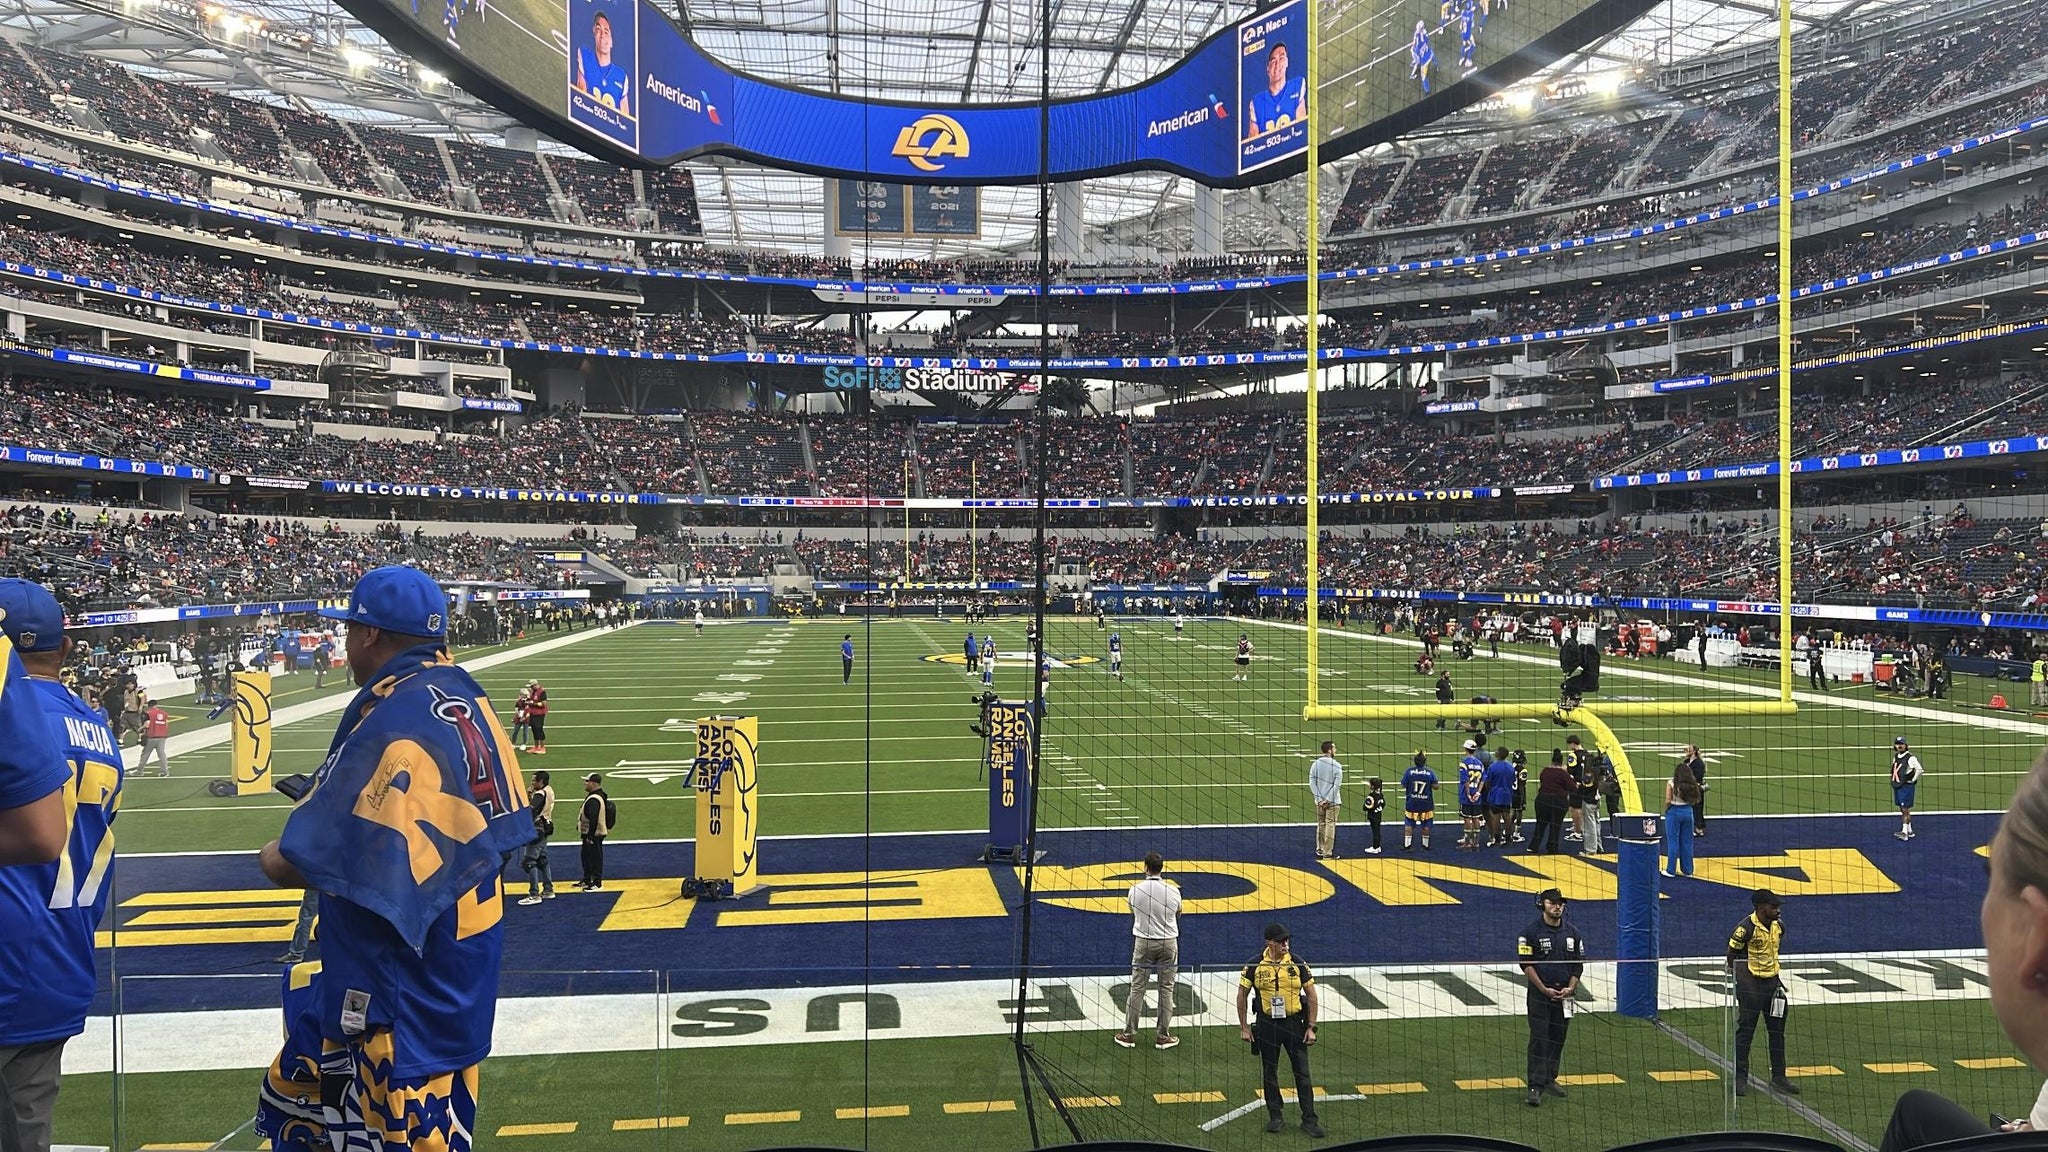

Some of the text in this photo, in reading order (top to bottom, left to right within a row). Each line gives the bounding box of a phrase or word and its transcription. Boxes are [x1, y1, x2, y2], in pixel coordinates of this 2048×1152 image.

[646, 73, 701, 113] American
[1148, 107, 1209, 138] American
[1266, 135, 1281, 148] 503
[856, 200, 886, 209] 1999
[930, 202, 959, 210] 2021
[1892, 257, 1938, 275] Forever forward
[816, 282, 844, 290] American
[911, 286, 938, 294] American
[1142, 286, 1168, 294] American
[1189, 284, 1216, 292] American
[746, 353, 764, 363] 100
[777, 354, 795, 364] 100
[1237, 354, 1254, 363] 100
[1326, 348, 1343, 358] 100
[804, 356, 827, 364] Forever
[894, 358, 911, 367] 100
[923, 358, 940, 367] 100
[952, 359, 968, 368] 100
[980, 359, 997, 368] 100
[1122, 358, 1139, 368] 100
[1151, 358, 1168, 368] 100
[1179, 356, 1196, 366] 100
[1208, 355, 1225, 365] 100
[193, 372, 256, 386] THERAMS.COM/TIX
[824, 366, 1000, 391] SoFi Stadium
[1989, 440, 2008, 454] 100
[2037, 436, 2048, 450] 10
[1901, 448, 1919, 463] 100
[1944, 445, 1963, 459] 100
[26, 451, 82, 466] Forever forward
[100, 458, 114, 470] 100
[1822, 457, 1838, 470] 100
[1860, 453, 1878, 467] 100
[131, 461, 146, 473] 100
[162, 464, 176, 476] 100
[1714, 465, 1766, 479] Forever forward
[1790, 461, 1802, 472] 00
[192, 468, 204, 479] 100
[1657, 473, 1671, 483] 100
[1687, 470, 1700, 481] 100
[1600, 478, 1612, 487] 100
[1628, 475, 1640, 486] 100
[336, 483, 638, 504] WELCOME TO THE ROYAL TOUR
[1191, 490, 1474, 507] WELCOME TO THE ROYAL TOUR
[1336, 589, 1420, 599] RAMS HOUSE
[1504, 594, 1592, 606] RAMS HOUSE
[318, 599, 349, 609] RAMS
[1886, 612, 1908, 620] RAMS
[64, 716, 114, 756] NACUA
[991, 707, 1002, 769] RAMS
[698, 725, 709, 793] RAMS
[1002, 707, 1014, 807] ANGELES
[1891, 762, 1902, 783] K
[1414, 781, 1426, 793] 17
[49, 756, 118, 910] 17
[94, 848, 1900, 947] ANGELE
[1666, 957, 1990, 995] KES
[998, 983, 1208, 1024] OF
[671, 991, 902, 1039] US
